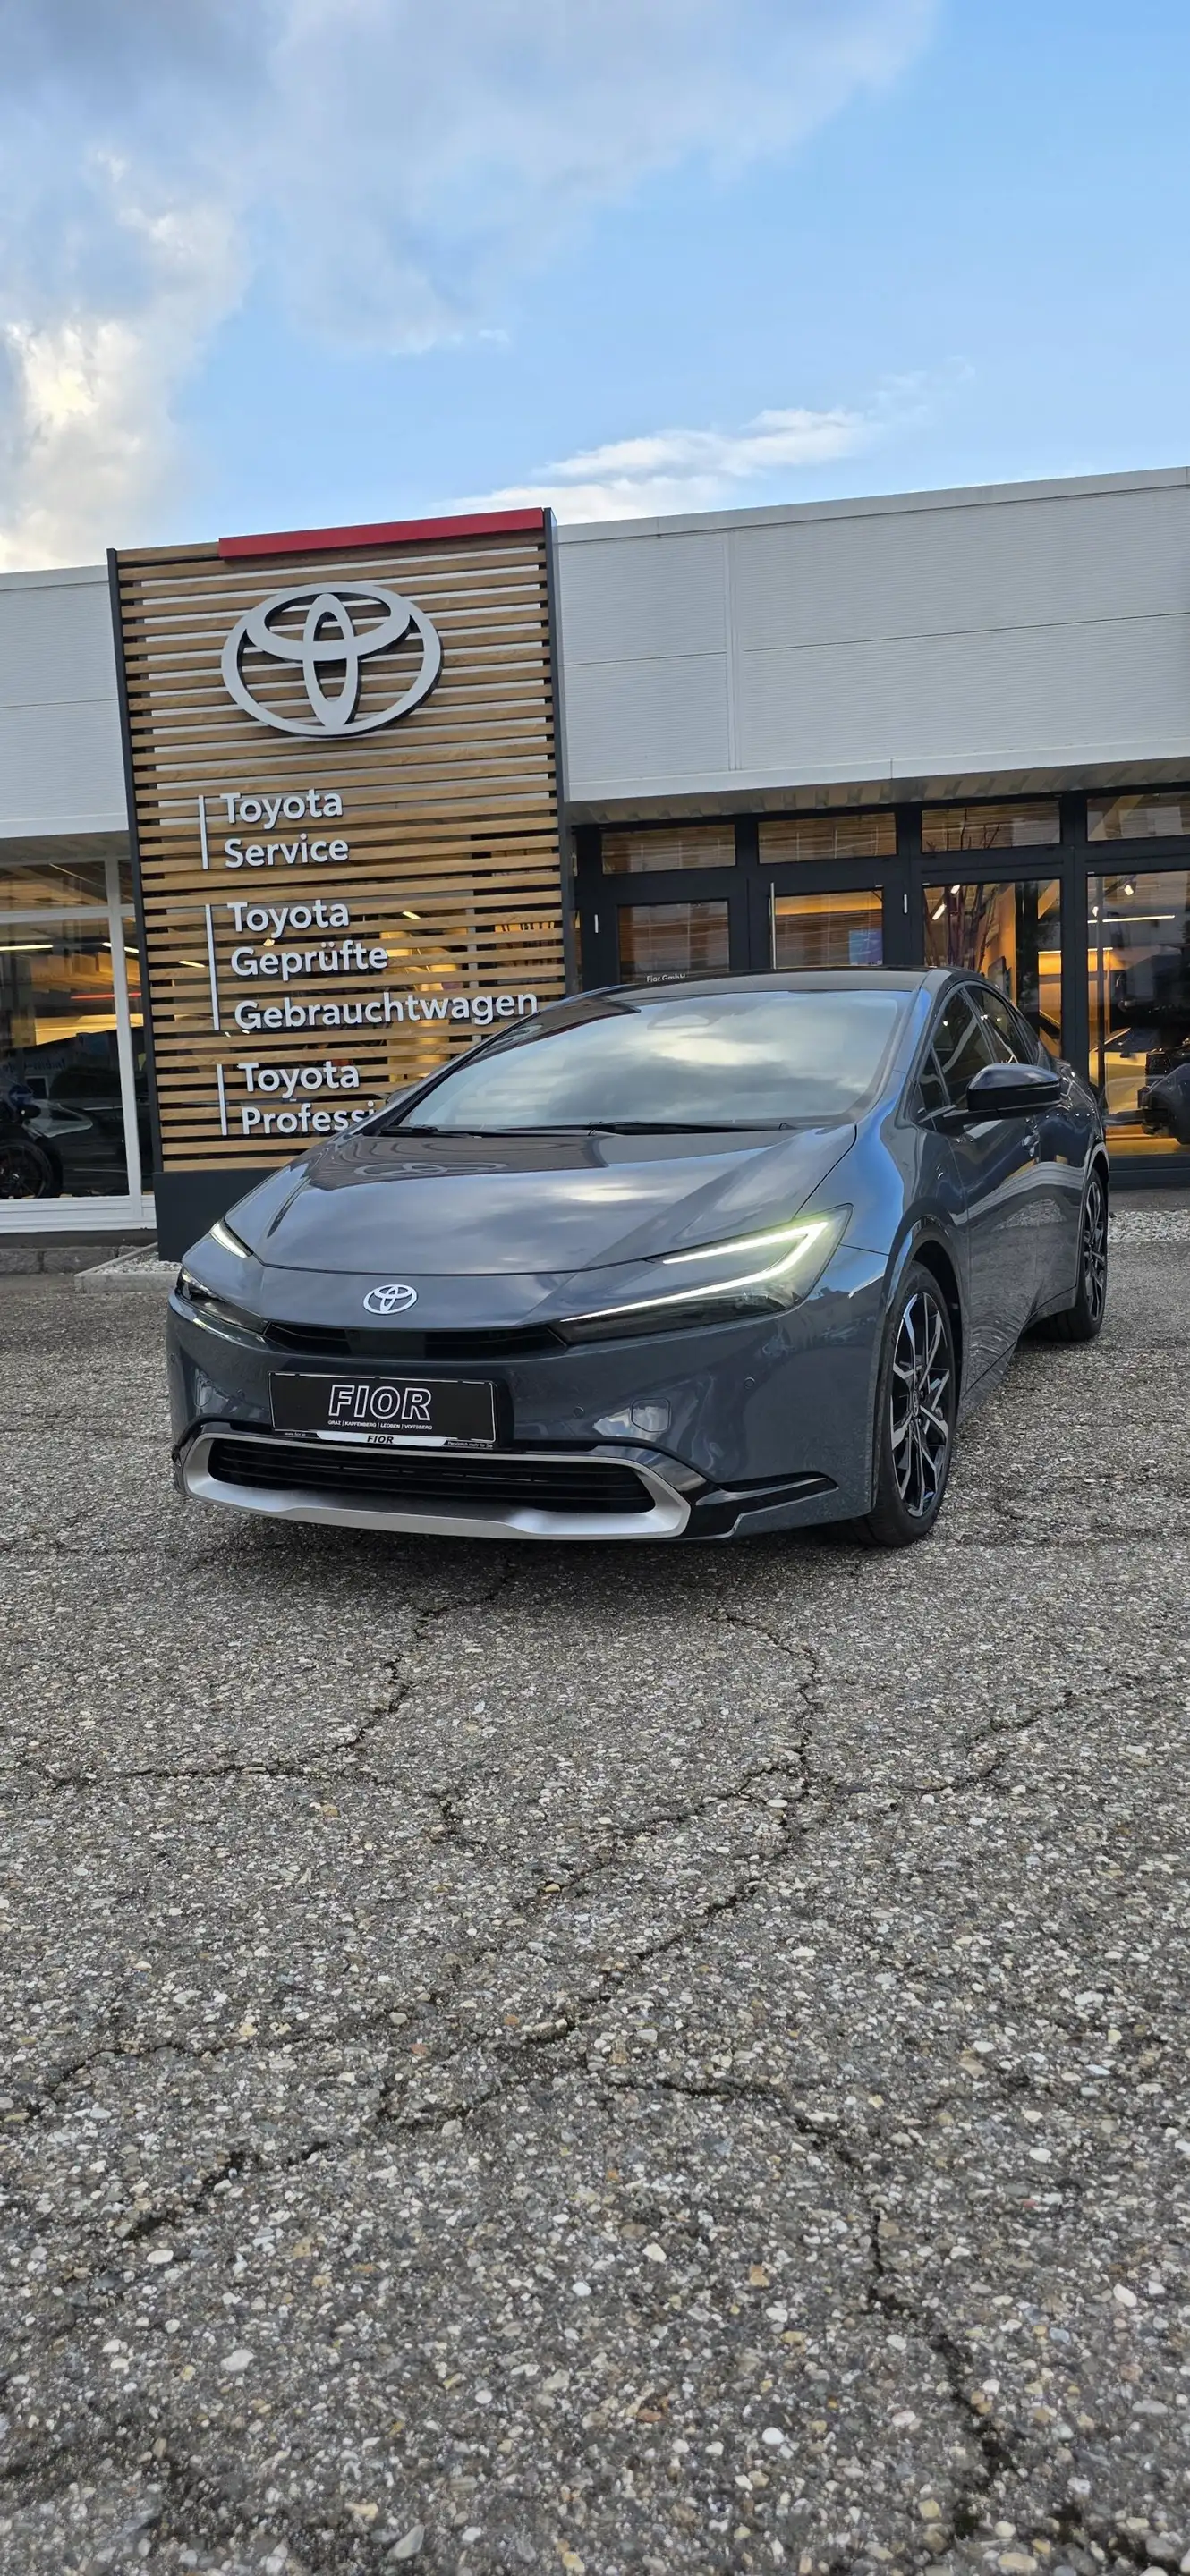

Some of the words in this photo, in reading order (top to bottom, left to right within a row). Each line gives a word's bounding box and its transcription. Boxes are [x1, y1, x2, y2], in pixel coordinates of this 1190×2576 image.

[220, 788, 343, 830] Toyota
[224, 833, 350, 869] Service
[227, 899, 350, 939] Toyota
[231, 940, 388, 982] Geprüfte
[234, 991, 538, 1030] Gebrauchtwagen
[237, 1061, 360, 1098] Toyota
[328, 1384, 431, 1421] FIOR
[367, 1435, 394, 1444] FIOR
